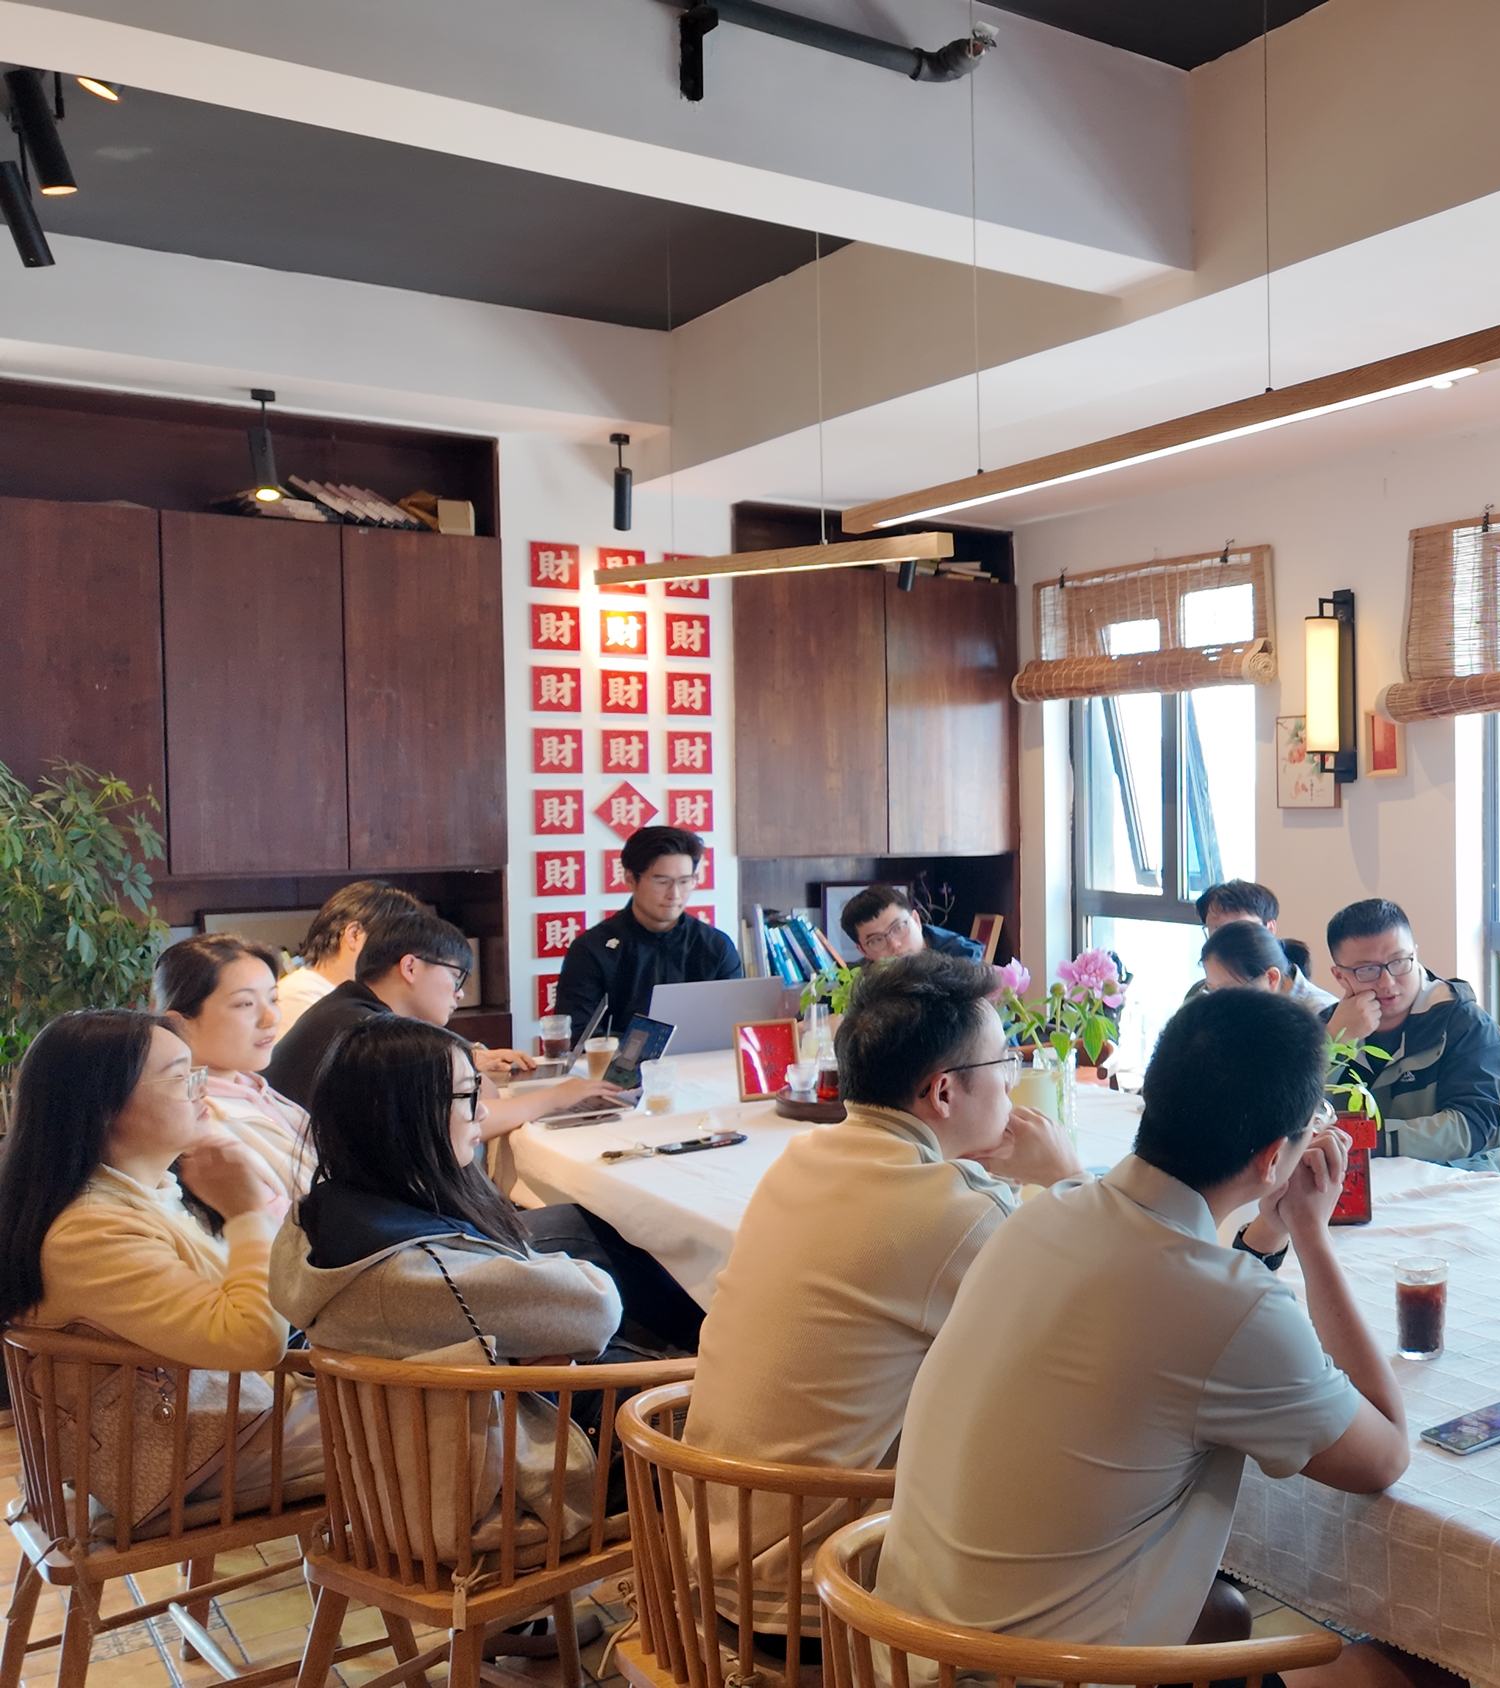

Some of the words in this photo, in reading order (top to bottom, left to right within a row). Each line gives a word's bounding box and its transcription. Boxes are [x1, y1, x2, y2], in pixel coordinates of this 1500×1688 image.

[537, 550, 574, 583] 財
[537, 611, 576, 645] 財
[605, 615, 642, 649] 財
[670, 620, 706, 652] 財
[539, 673, 576, 707] 財
[606, 676, 642, 708] 財
[671, 679, 706, 711] 財
[540, 735, 578, 768] 財
[607, 735, 644, 768] 財
[672, 737, 707, 768] 財
[541, 796, 579, 829] 財
[608, 795, 645, 829] 財
[673, 795, 708, 827] 財
[542, 857, 580, 890] 財
[543, 917, 581, 951] 財
